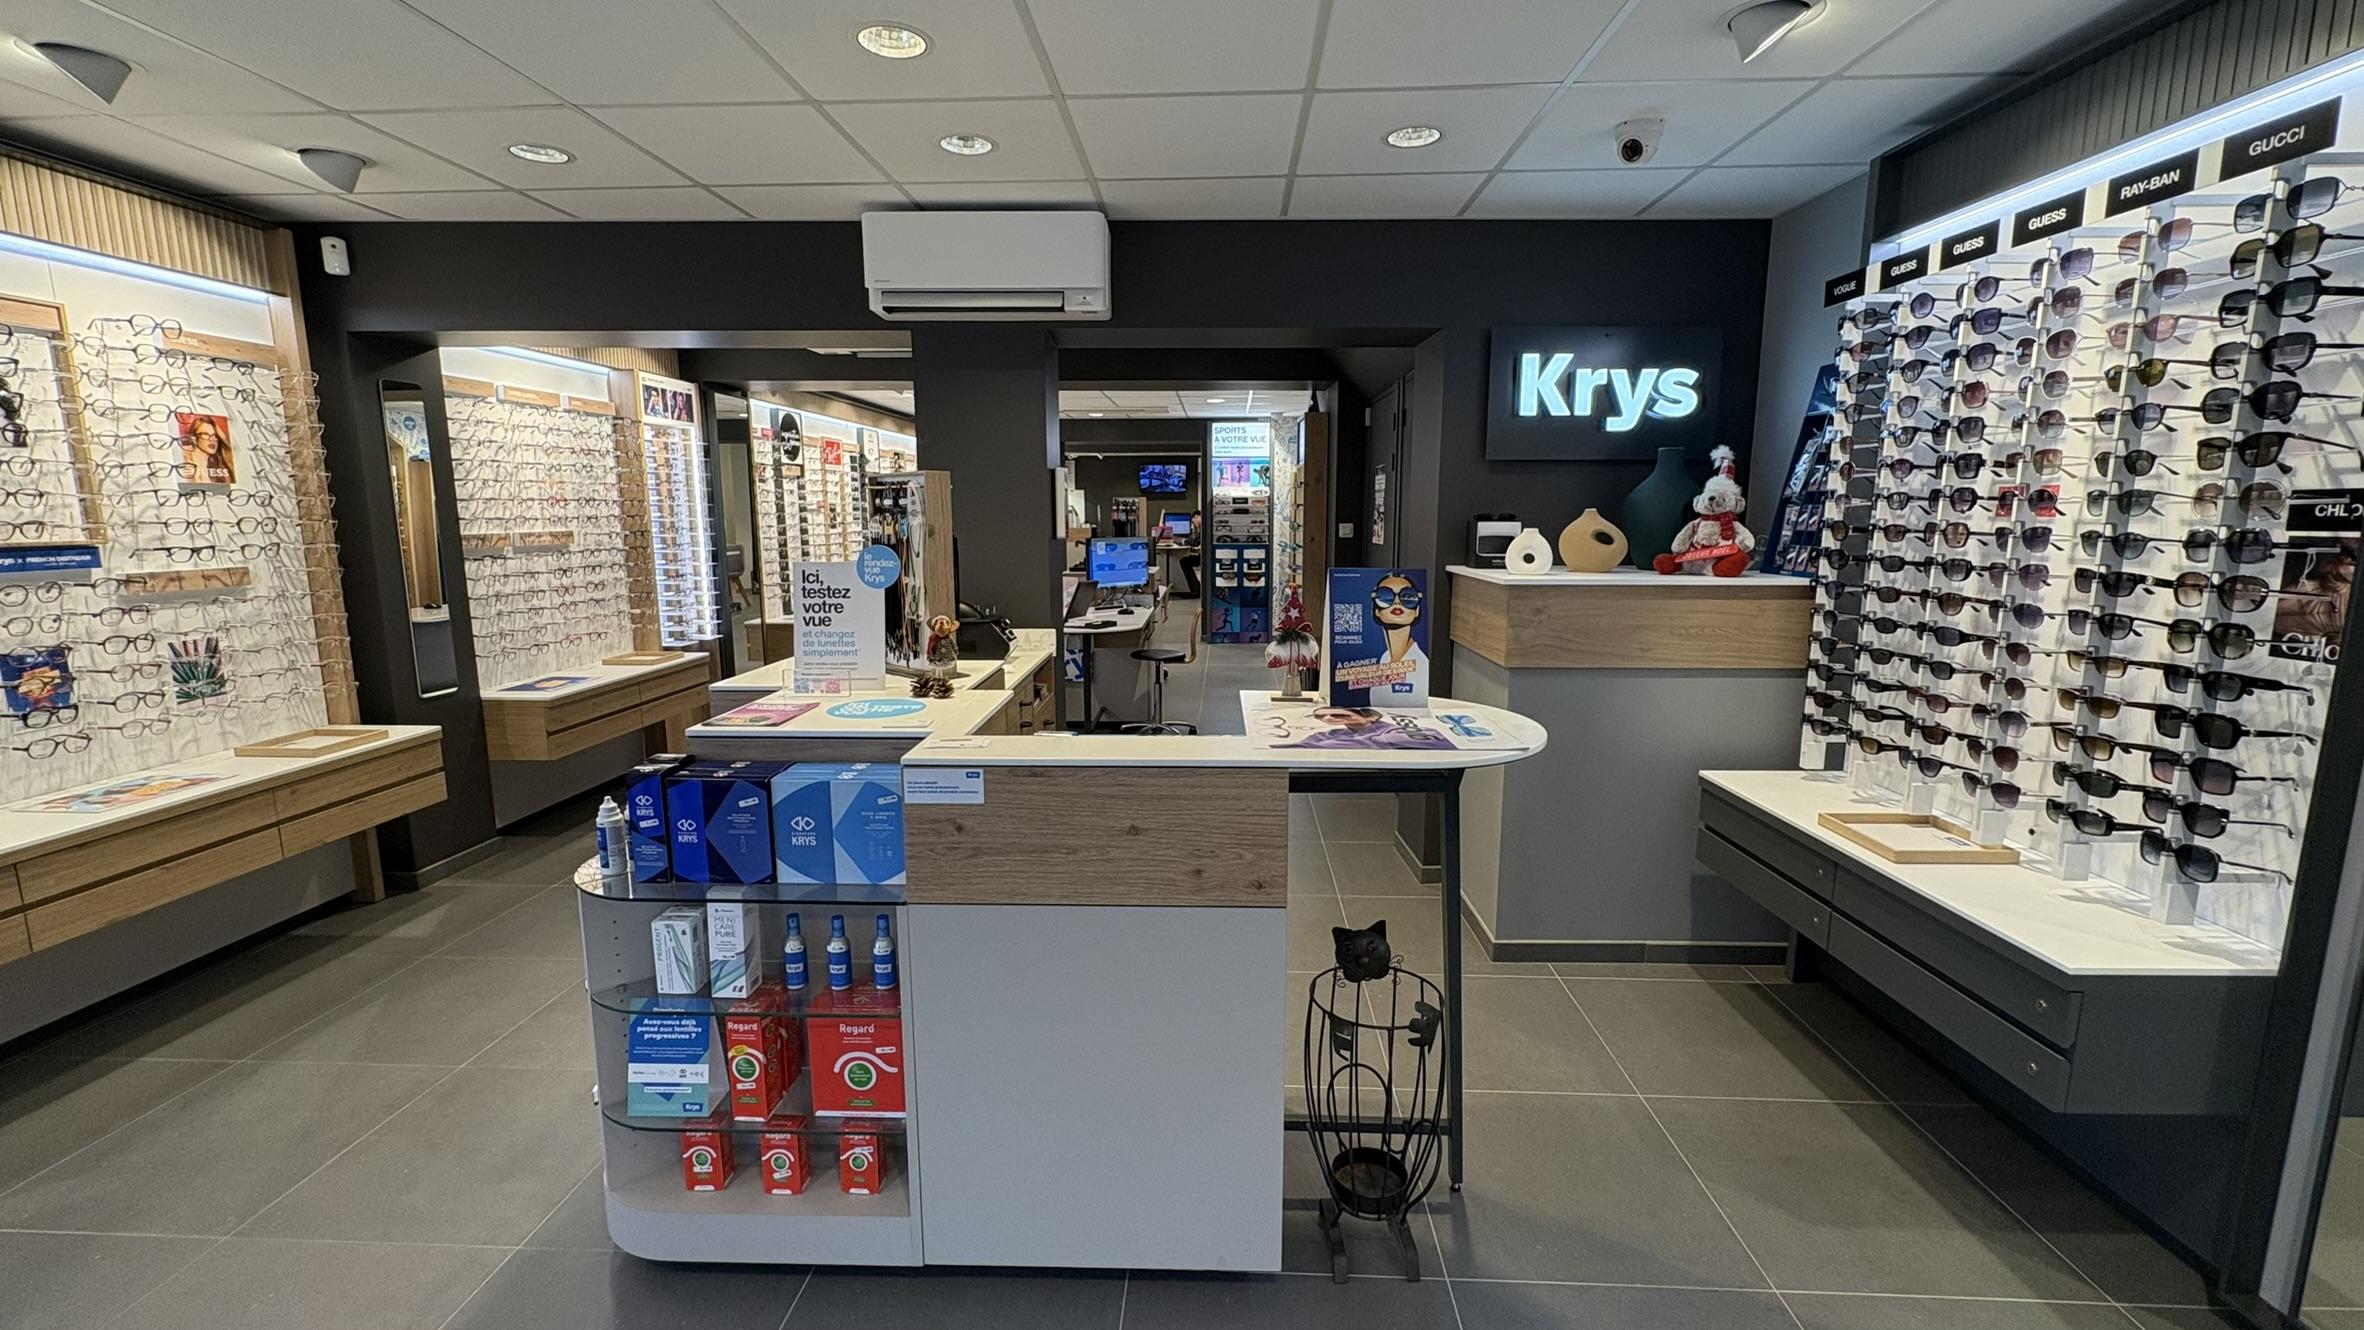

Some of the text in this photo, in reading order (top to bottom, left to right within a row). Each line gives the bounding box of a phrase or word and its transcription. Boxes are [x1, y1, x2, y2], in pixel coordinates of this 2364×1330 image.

[2249, 125, 2305, 156] GUCCI
[2120, 169, 2180, 200] RAY-BAN
[2028, 208, 2067, 231] GUESS
[1952, 236, 1985, 256] GUESS
[1890, 259, 1918, 277] GUESS
[1833, 280, 1857, 296] VOGUE
[1518, 352, 1700, 432] Krys
[1214, 426, 1247, 434] SPORTS
[864, 552, 872, 560] le
[864, 559, 897, 567] rendez-
[802, 569, 824, 586] Ici,
[864, 574, 886, 583] Krys
[801, 586, 851, 599] testez
[802, 600, 844, 614] votre
[802, 616, 832, 627] vue
[803, 630, 855, 641] et changez
[803, 639, 856, 648] de lunettes
[792, 836, 816, 846] KRYS
[728, 1022, 758, 1032] Regard
[839, 1024, 874, 1035] Regard
